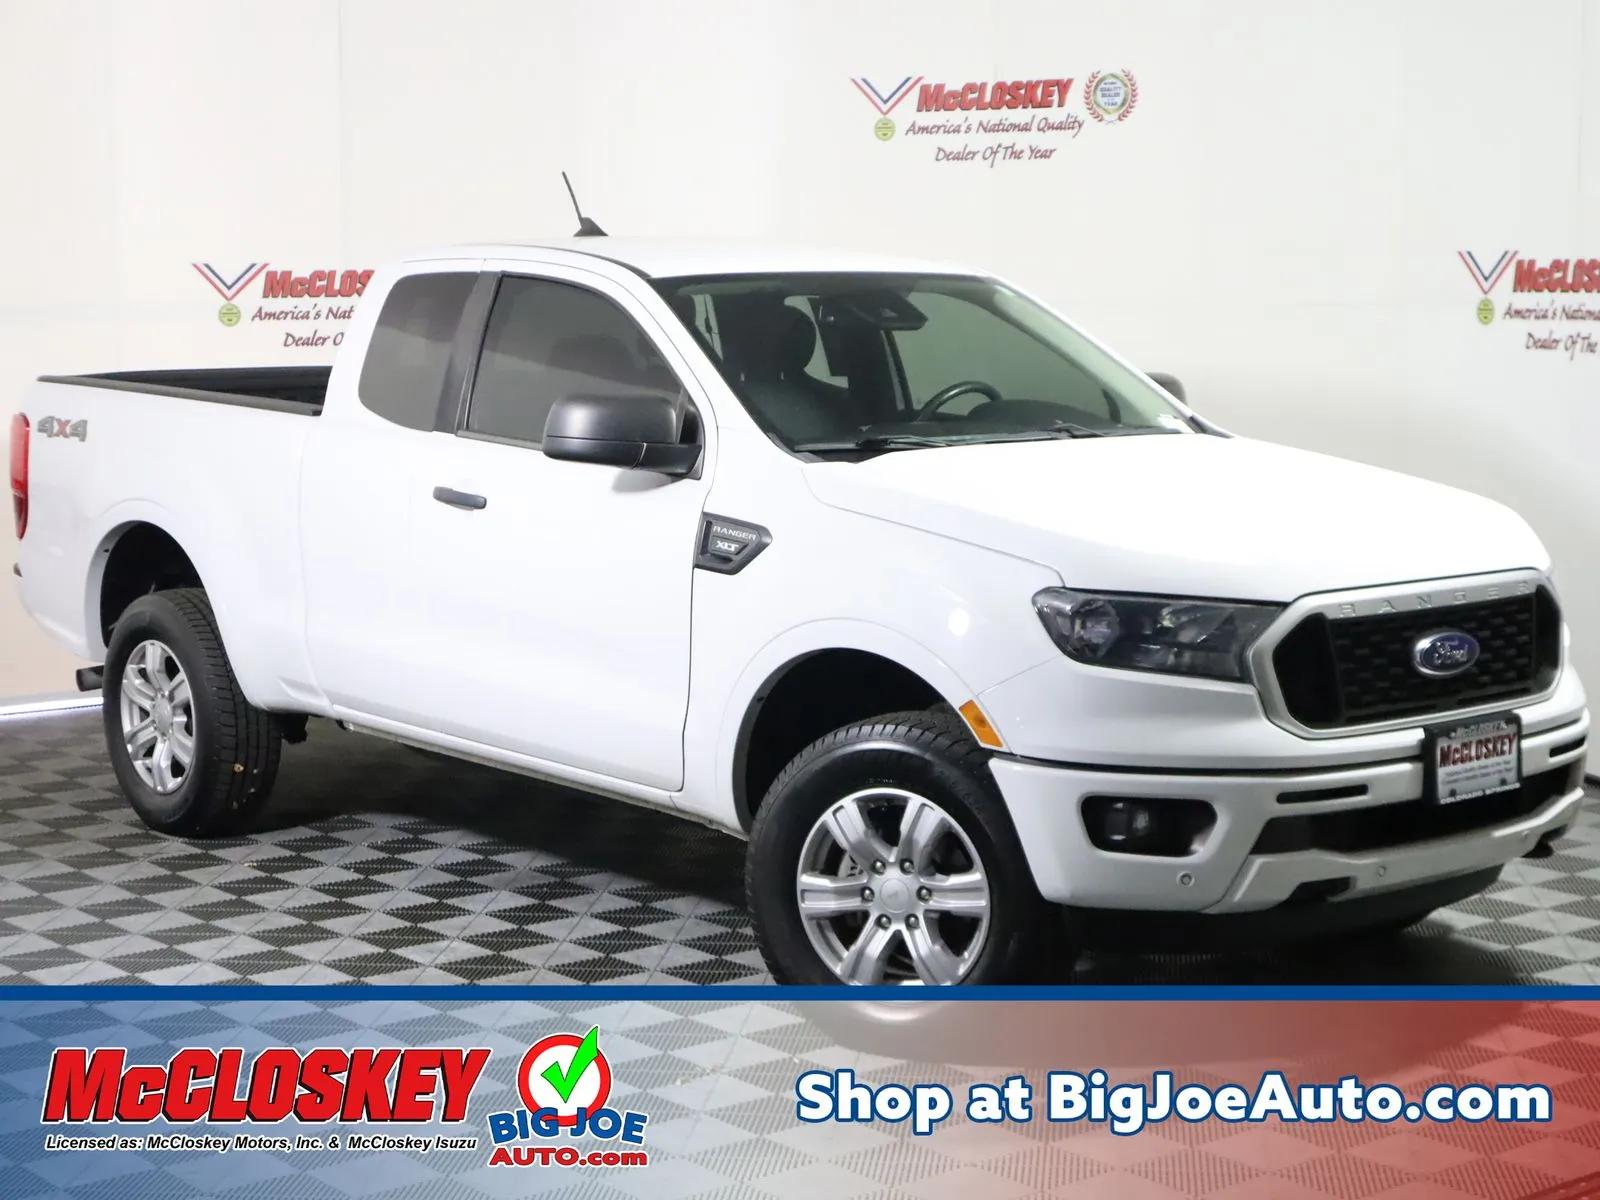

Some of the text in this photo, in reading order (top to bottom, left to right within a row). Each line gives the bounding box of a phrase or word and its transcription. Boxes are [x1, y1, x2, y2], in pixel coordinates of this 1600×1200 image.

[917, 78, 1074, 112] McCLOSKEY
[905, 113, 1085, 138] America's National Quality
[934, 142, 1056, 168] Dealer Of The Year
[251, 303, 321, 322] America's
[1502, 298, 1558, 320] America's
[282, 329, 330, 348] Dealer
[1525, 329, 1561, 350] Dealer
[713, 525, 757, 540] RANGER
[716, 540, 739, 552] XLT
[1339, 582, 1530, 617] RANGER
[1433, 638, 1470, 664] Ford
